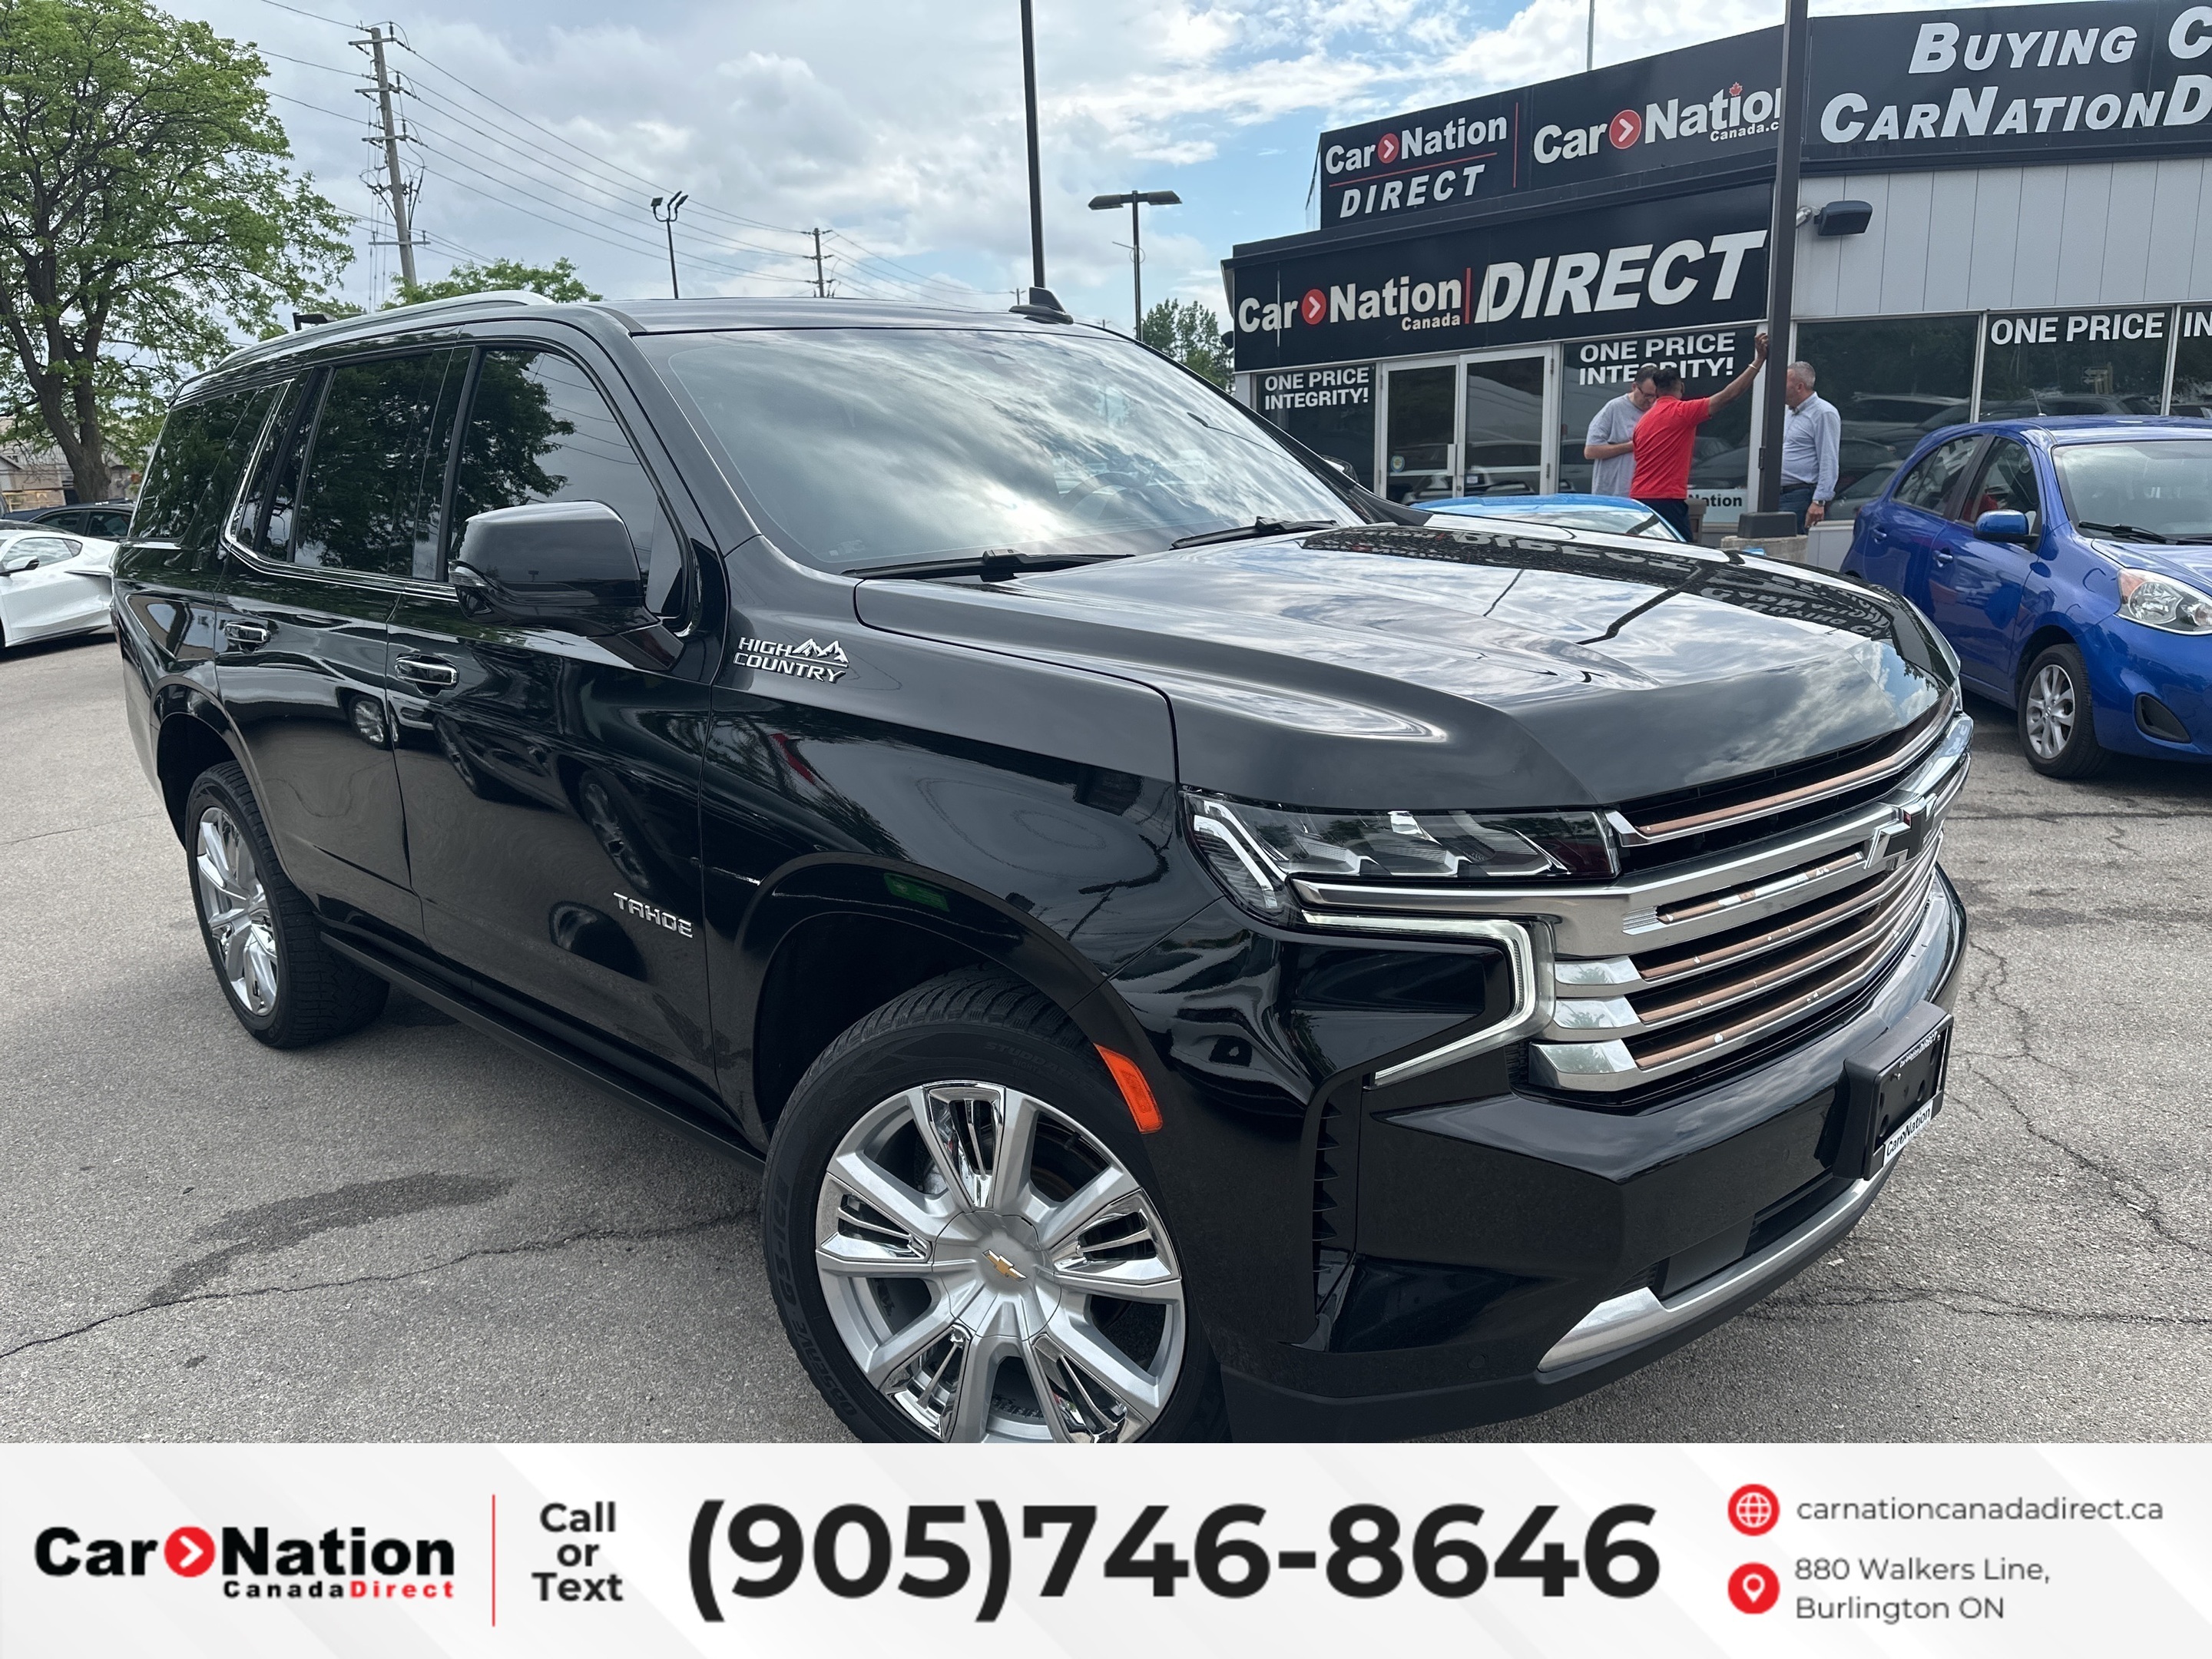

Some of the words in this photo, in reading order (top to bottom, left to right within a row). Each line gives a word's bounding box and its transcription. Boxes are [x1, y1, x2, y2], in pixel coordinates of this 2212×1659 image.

[1909, 22, 2137, 74] BUYING
[1534, 122, 1608, 164] Car
[1644, 87, 1781, 144] Natio
[1325, 144, 1376, 174] Car
[1401, 116, 1507, 159] Nation
[1339, 164, 1485, 218] DIRECT
[1238, 296, 1299, 333] Car
[1330, 275, 1462, 323] Nation
[1474, 230, 1767, 324] DIRECT
[1401, 313, 1461, 331] Canada
[1991, 317, 2059, 345] ONE
[2066, 312, 2165, 342] PRICE
[1580, 340, 1637, 363] ONE
[1645, 332, 1736, 358] PRICE
[1265, 372, 1304, 392] ONE
[1309, 366, 1369, 387] PRICE
[1579, 356, 1734, 386] INTEITY!
[1265, 387, 1369, 410] INTEGRITY!
[738, 637, 794, 657] HIGH
[733, 652, 846, 684] COUNTRY
[614, 892, 693, 939] TAHOE
